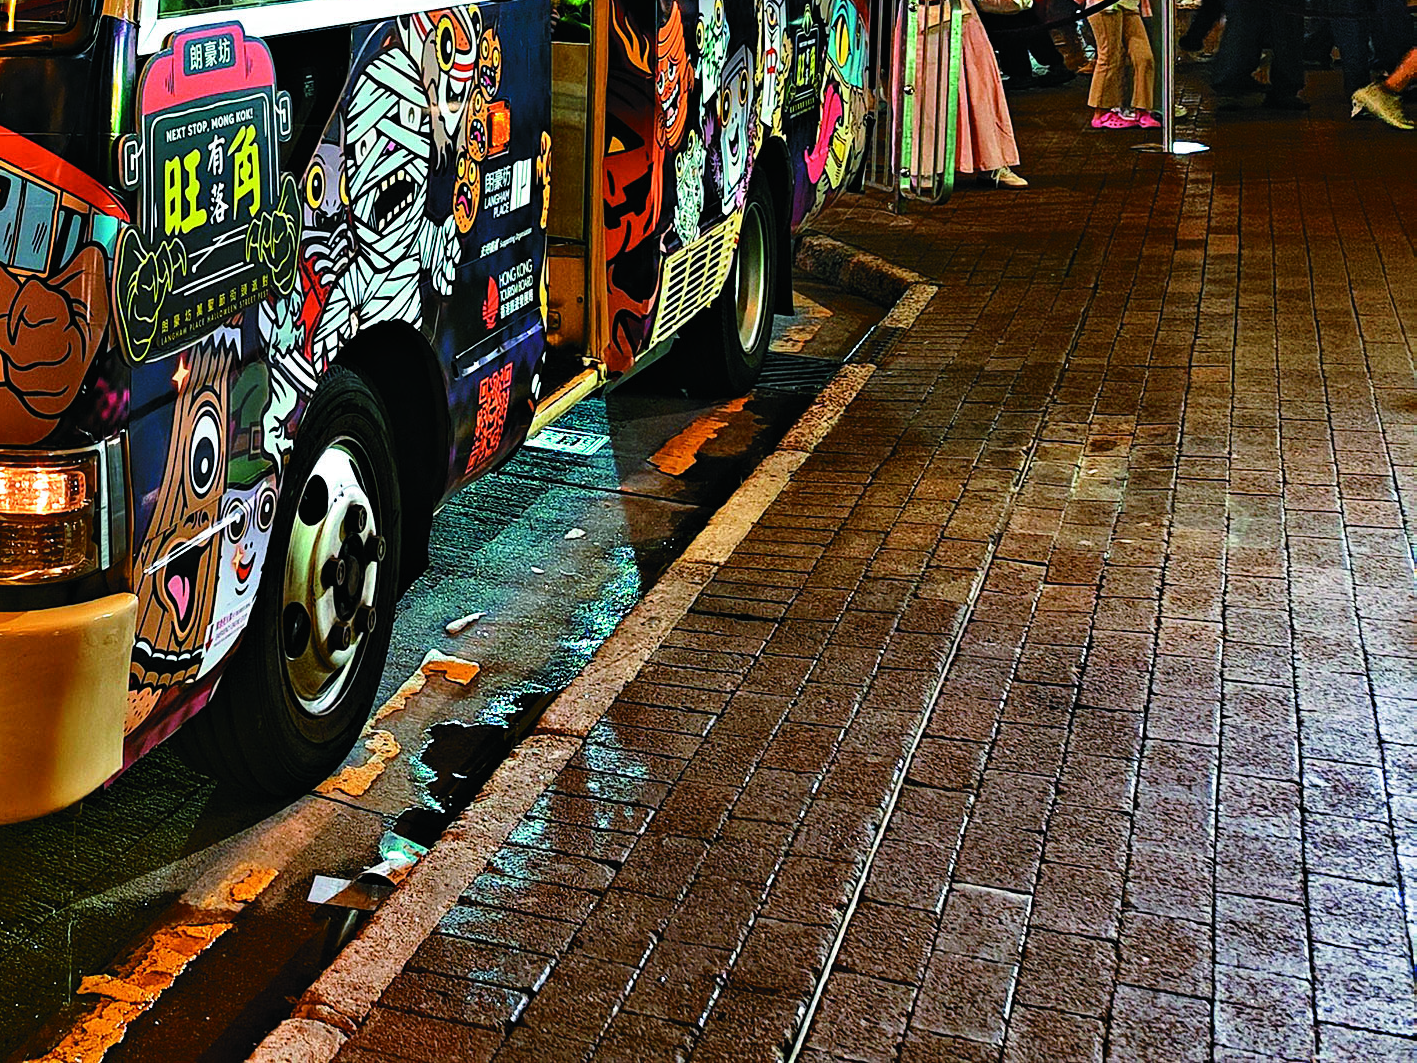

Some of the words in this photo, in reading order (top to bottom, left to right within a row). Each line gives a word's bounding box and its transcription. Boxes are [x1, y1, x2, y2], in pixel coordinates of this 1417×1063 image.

[189, 38, 231, 71] 朗豪坊
[165, 125, 185, 144] NEXT
[210, 114, 235, 132] MONG
[235, 108, 254, 127] KOK!
[484, 166, 511, 195] 朗豪坊
[484, 189, 510, 210] LANGHAM
[493, 201, 510, 219] PLACE
[498, 265, 516, 288] HONG
[515, 258, 533, 279] KONG
[161, 327, 187, 346] LANGHAM
[189, 318, 205, 331] PLACE
